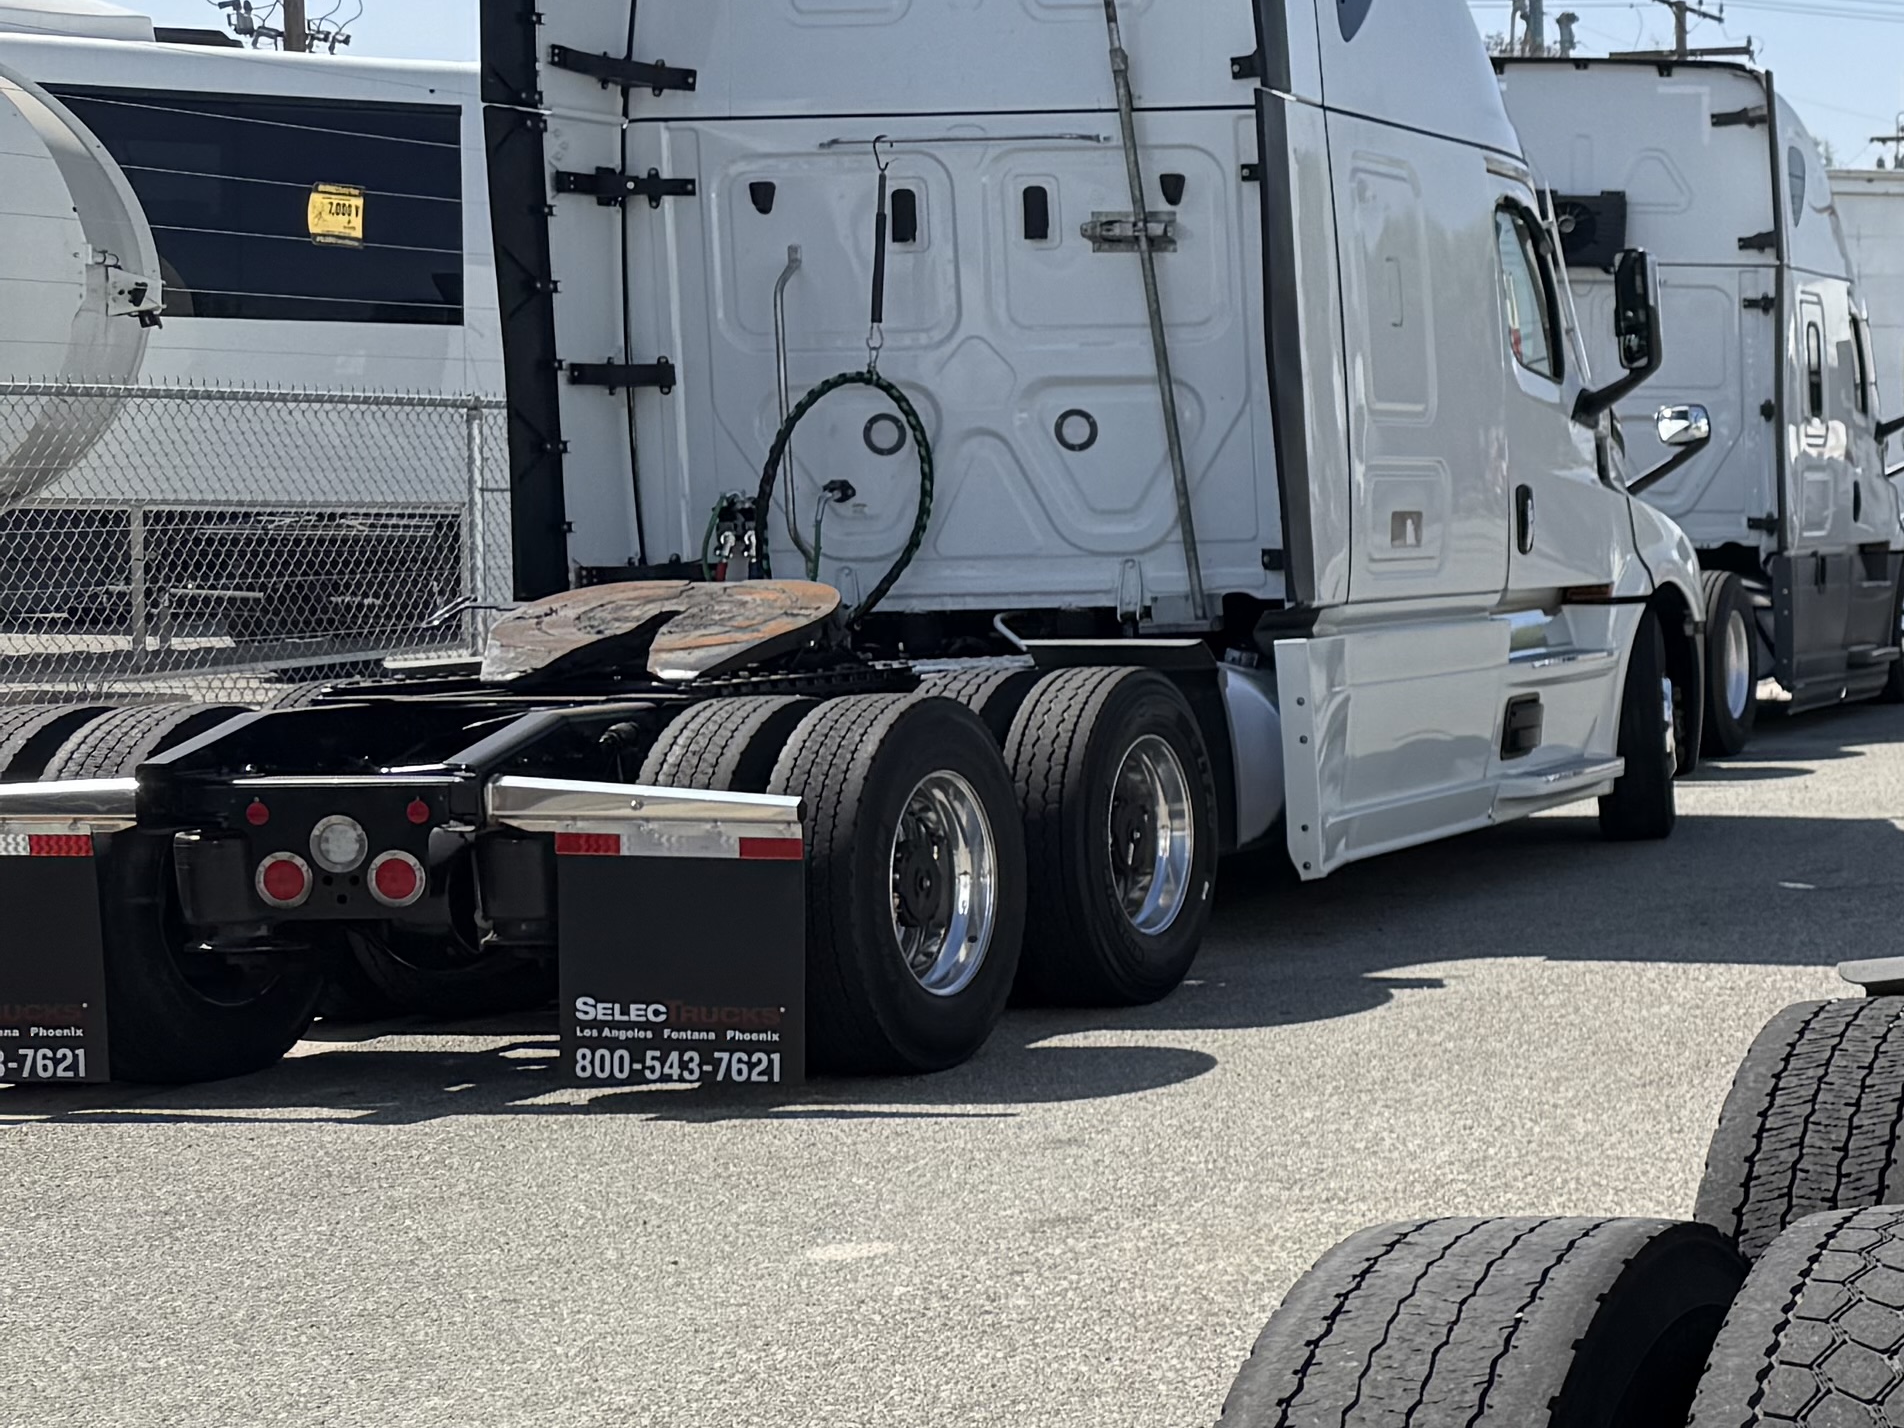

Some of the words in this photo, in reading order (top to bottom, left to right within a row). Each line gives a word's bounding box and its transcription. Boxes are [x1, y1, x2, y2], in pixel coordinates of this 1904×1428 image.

[576, 1025, 599, 1038] Los
[601, 1026, 653, 1041] Angeles
[663, 1028, 716, 1040] Fontana
[726, 1029, 780, 1042] Phoenix
[575, 1047, 781, 1083] 800-543-7621
